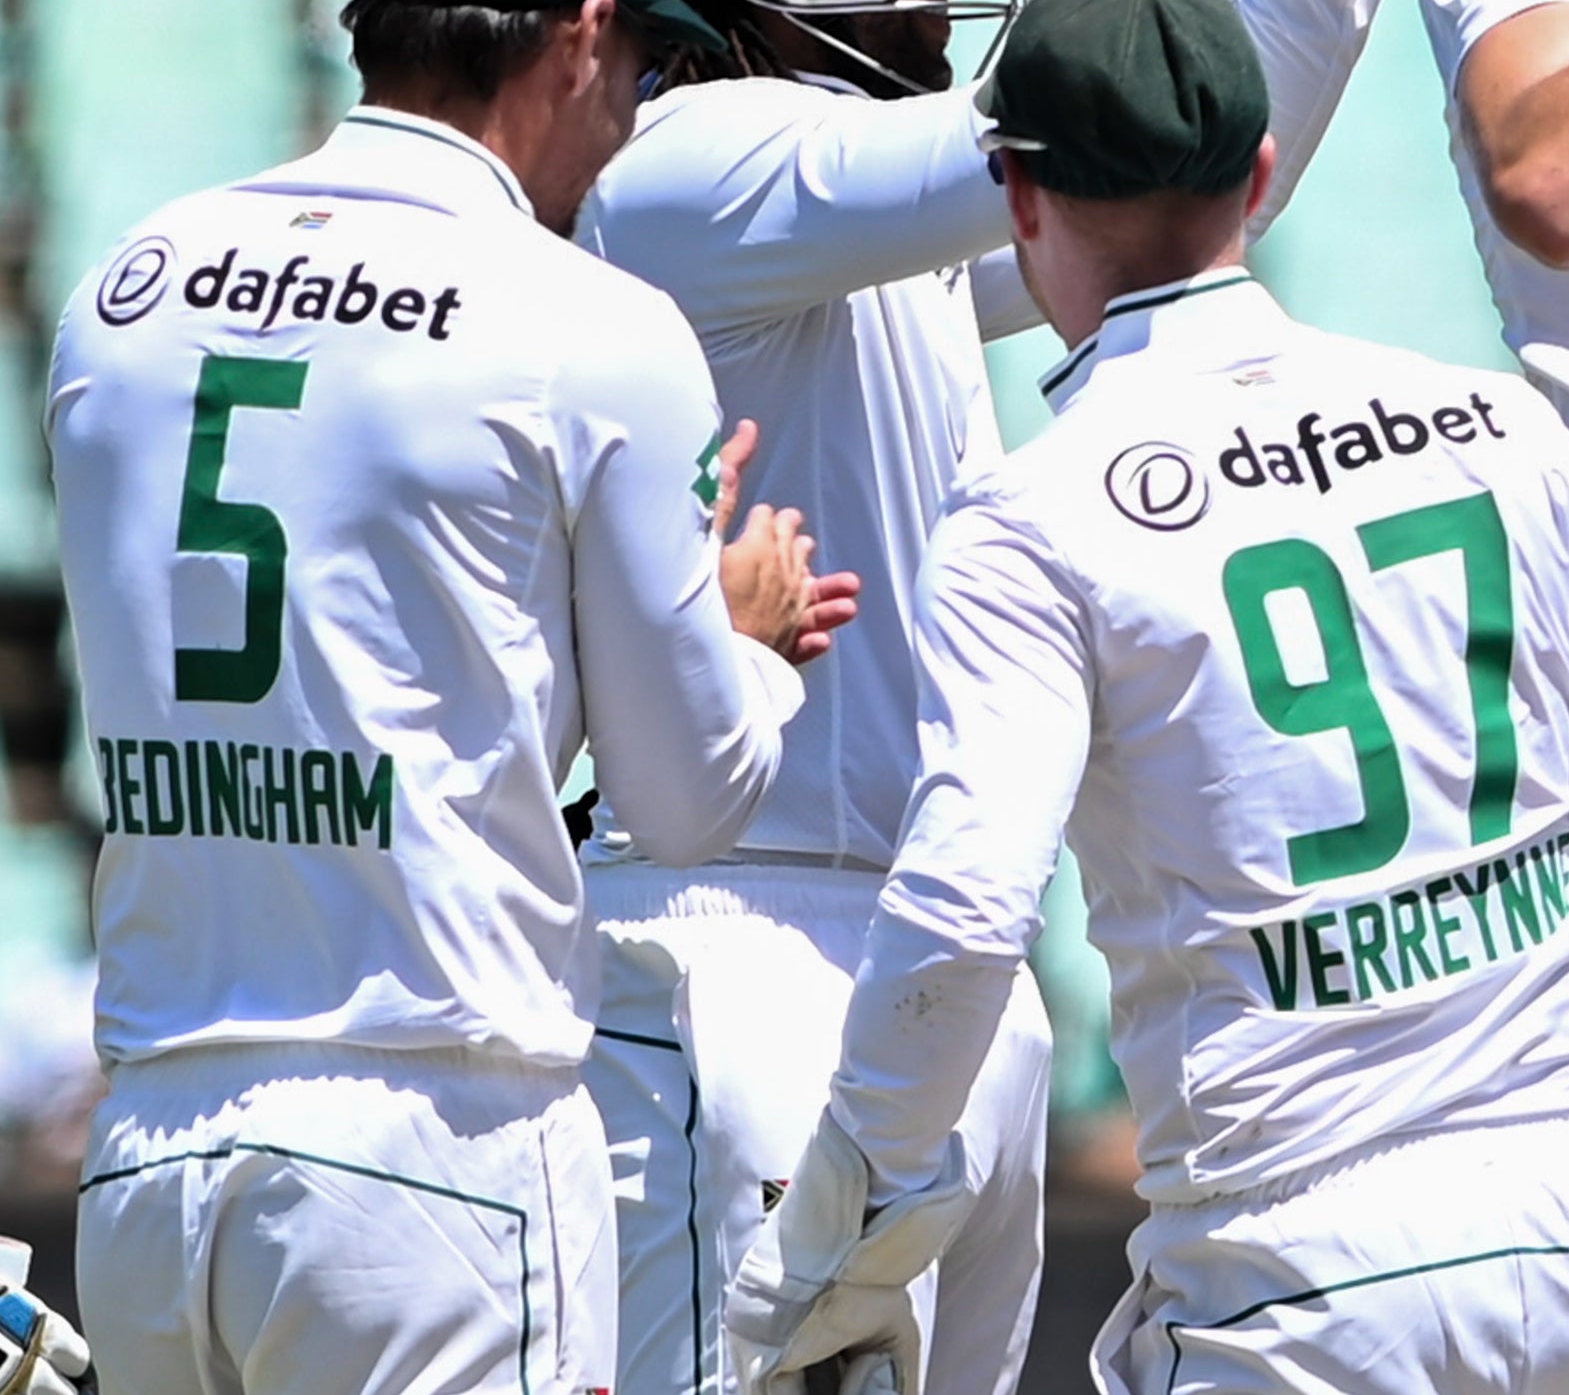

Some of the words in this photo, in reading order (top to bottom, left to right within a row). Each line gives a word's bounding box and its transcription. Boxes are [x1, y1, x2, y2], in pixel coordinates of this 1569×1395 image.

[184, 248, 462, 341] dafabet
[175, 355, 309, 703] 5
[1219, 392, 1507, 495] dafabet
[1221, 491, 1519, 887] 97
